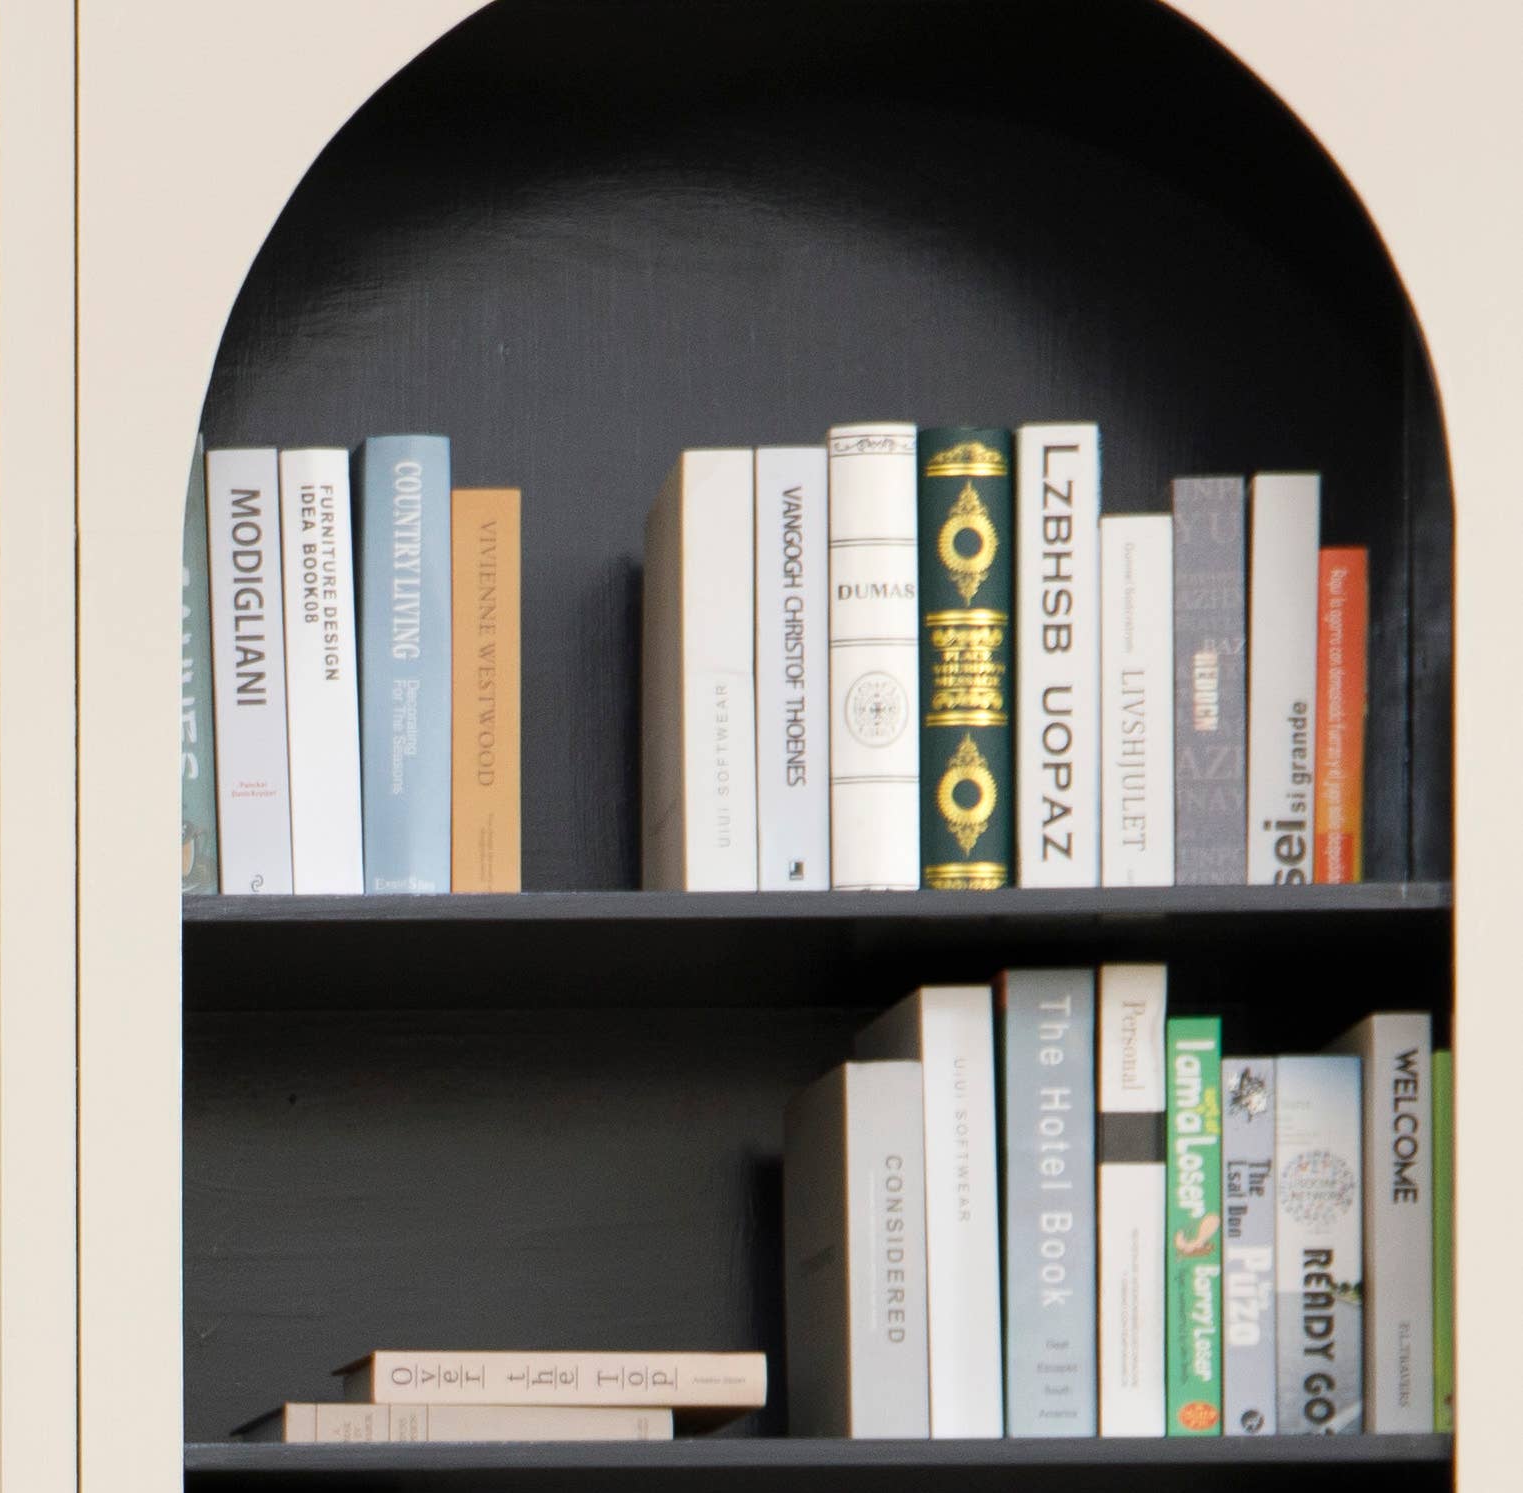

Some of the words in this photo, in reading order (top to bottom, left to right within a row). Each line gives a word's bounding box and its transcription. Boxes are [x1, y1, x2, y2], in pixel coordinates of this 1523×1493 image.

[300, 485, 316, 532] IDEA
[320, 485, 338, 599] FURNITURE
[393, 460, 422, 575] COUNTRY
[782, 486, 802, 589] VANGOGH
[1042, 443, 1080, 655] LZBHSB
[230, 488, 267, 707] MODIGLIANI
[303, 543, 319, 624] BOOK08
[393, 578, 422, 660] LIVING
[479, 520, 497, 636] VIVIENNE
[838, 583, 915, 601] DUMAS
[324, 607, 340, 681] DESIGN
[784, 597, 805, 690] CHRISTOF
[478, 643, 497, 787] WESTWOOD
[716, 684, 730, 796] SOFTWEAR
[786, 697, 806, 787] THOENES
[1288, 699, 1314, 786] grande
[1042, 685, 1073, 863] UOPAZ
[1039, 996, 1072, 1065] The
[1121, 1000, 1146, 1091] Personal
[954, 1111, 971, 1223] SOFTWEAR
[1040, 1089, 1073, 1189] Hotel
[1392, 1047, 1419, 1204] WELCOME
[1176, 1136, 1217, 1218] Loser
[1249, 1159, 1272, 1197] The
[886, 1155, 905, 1343] CONSIDERED
[1041, 1212, 1073, 1308] Book
[1304, 1249, 1336, 1361] READY
